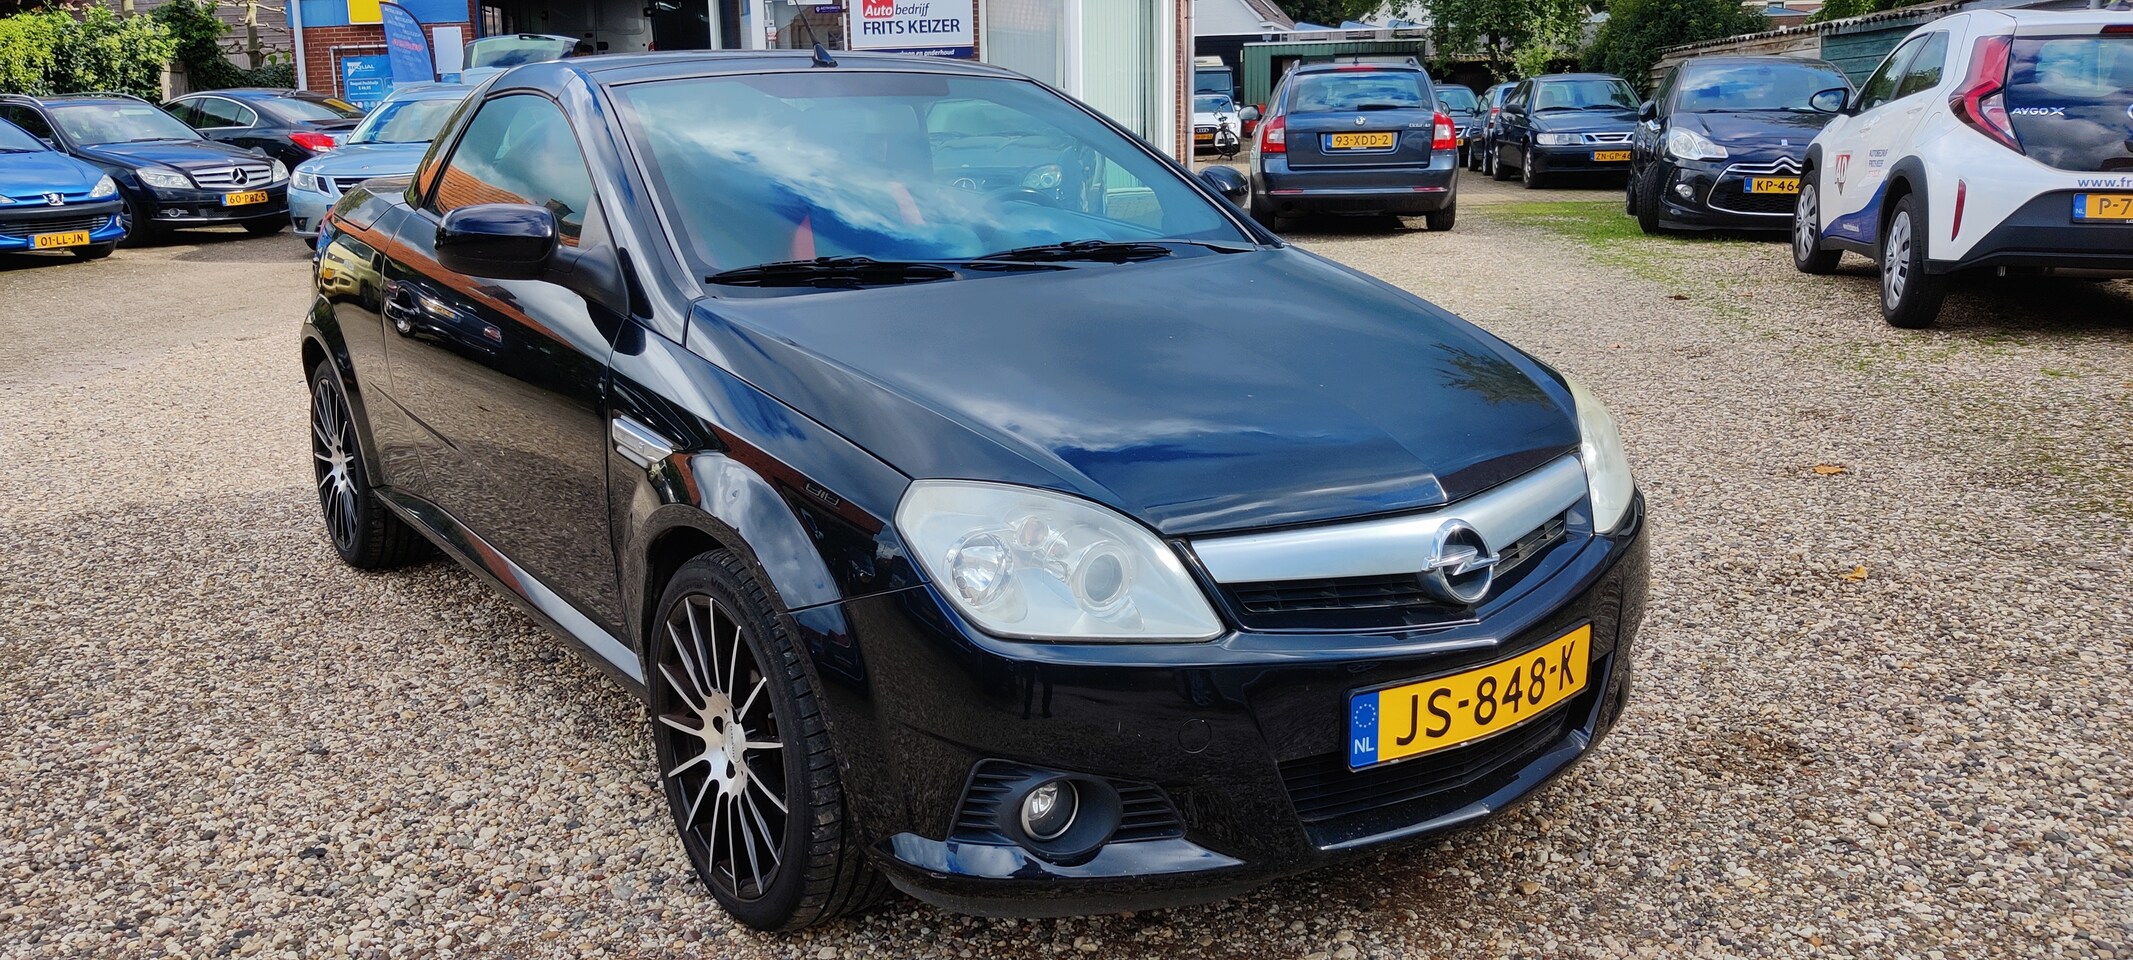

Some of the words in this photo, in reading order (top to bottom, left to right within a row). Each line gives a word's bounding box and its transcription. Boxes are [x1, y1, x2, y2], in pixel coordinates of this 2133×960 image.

[864, 5, 893, 17] Auto
[895, 3, 930, 17] bedrijf
[863, 21, 905, 35] FRITS
[908, 19, 961, 34] KEIZER
[1335, 135, 1388, 146] 93-XDD-2
[229, 192, 266, 204] 60-PBZ-5
[2098, 198, 2133, 215] P-7
[41, 233, 83, 246] 01-LL-JN
[1396, 640, 1575, 746] JS-848-K
[1354, 736, 1374, 754] NL
